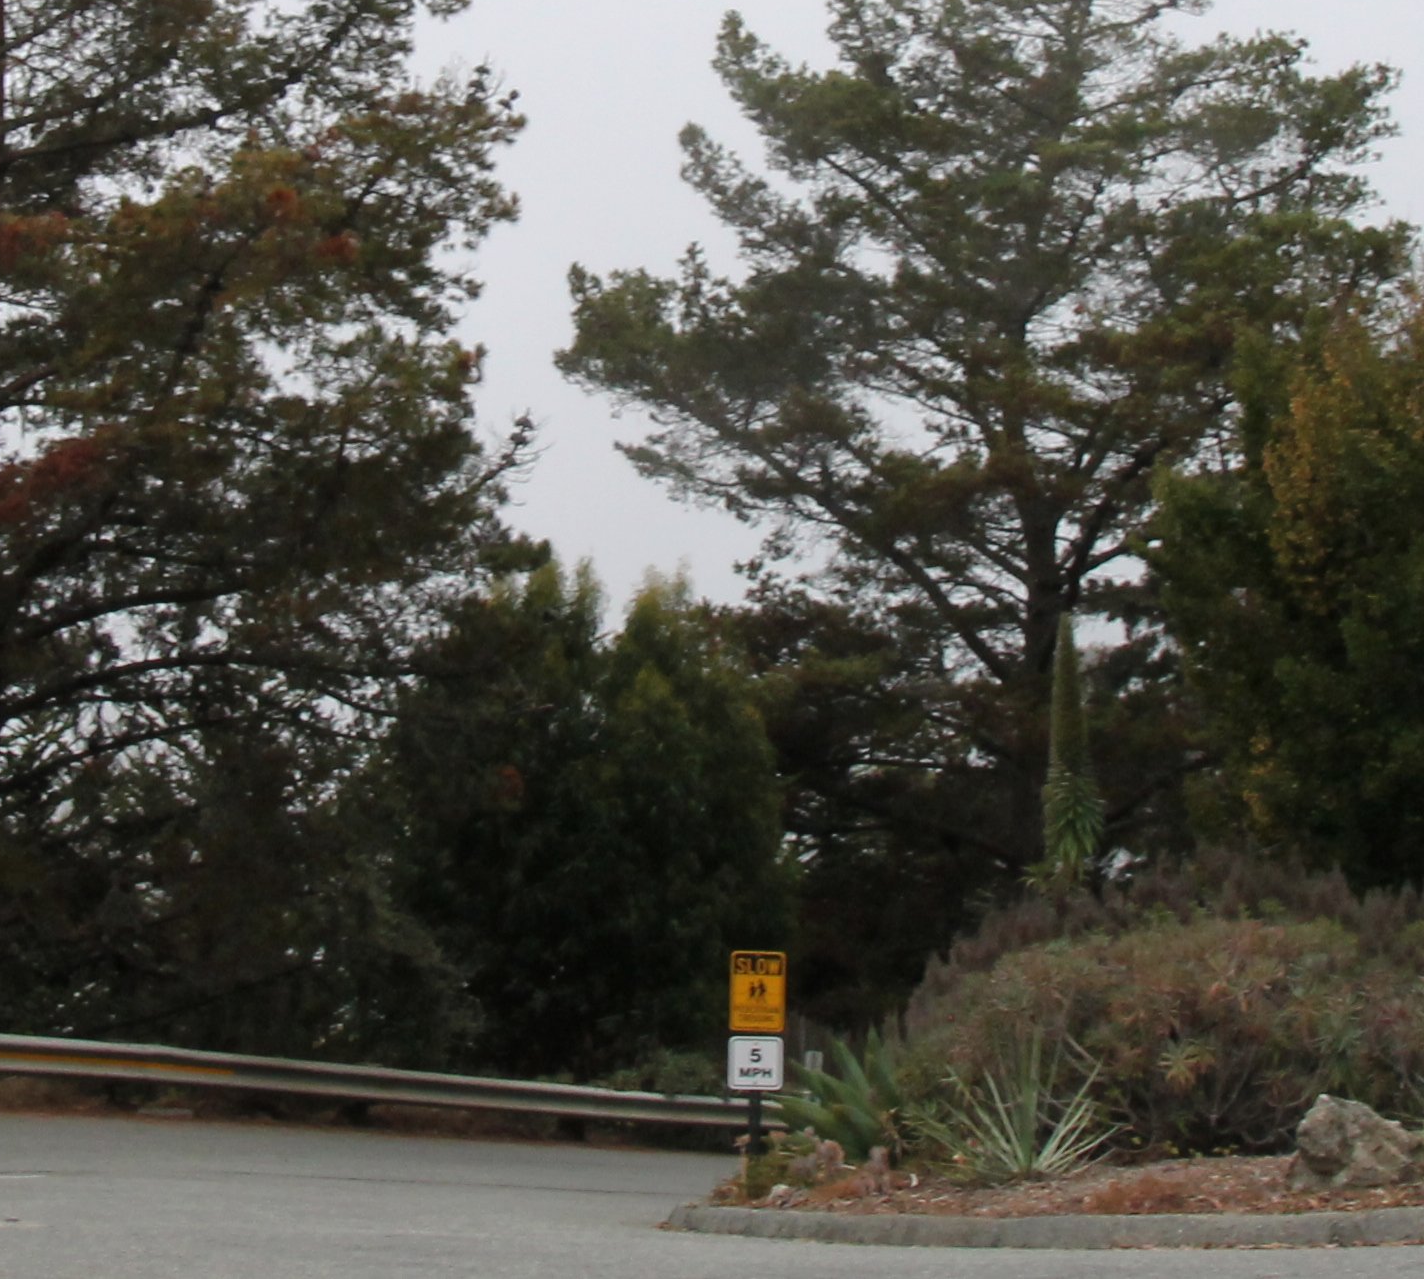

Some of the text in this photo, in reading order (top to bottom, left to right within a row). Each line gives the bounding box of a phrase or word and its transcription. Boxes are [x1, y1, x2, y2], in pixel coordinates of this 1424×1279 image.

[735, 957, 782, 975] SLOW
[750, 1048, 762, 1063] 5
[739, 1067, 773, 1078] MPH
